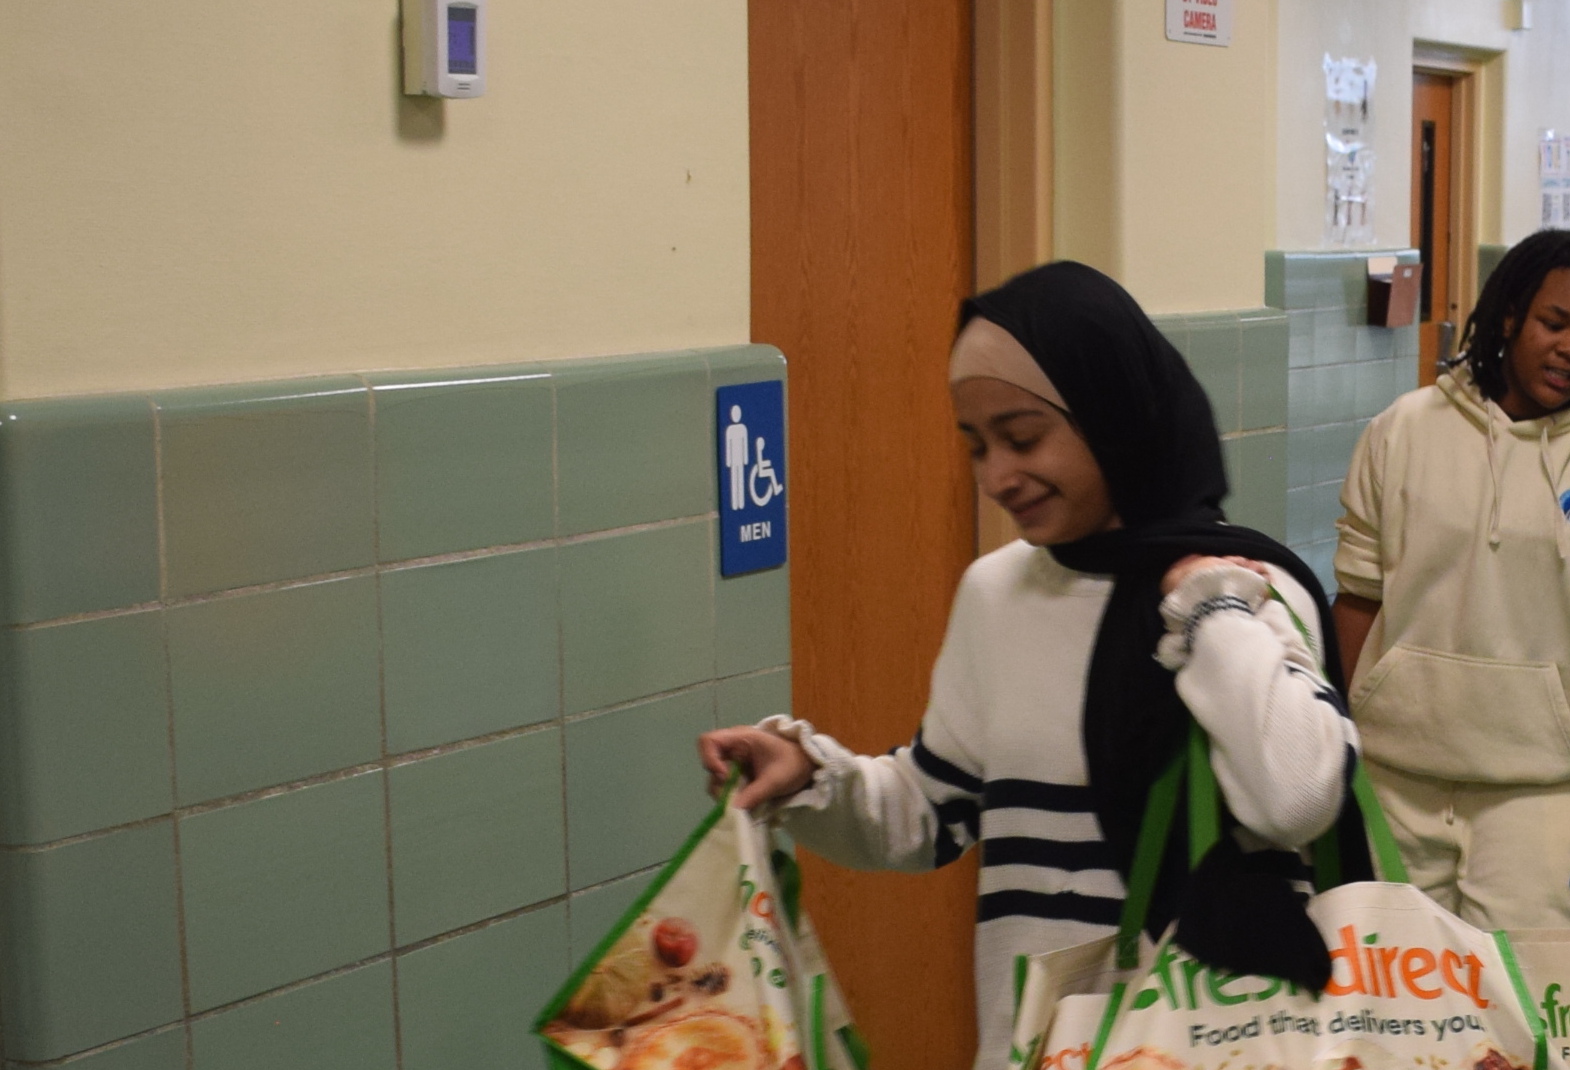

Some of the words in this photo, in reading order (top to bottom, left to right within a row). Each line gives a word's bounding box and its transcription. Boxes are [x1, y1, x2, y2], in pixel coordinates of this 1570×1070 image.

[1183, 9, 1216, 31] CAMERA
[740, 520, 771, 543] MEN
[1189, 1014, 1261, 1048] Food
[1269, 1009, 1321, 1037] that
[1328, 1010, 1425, 1037] delivers
